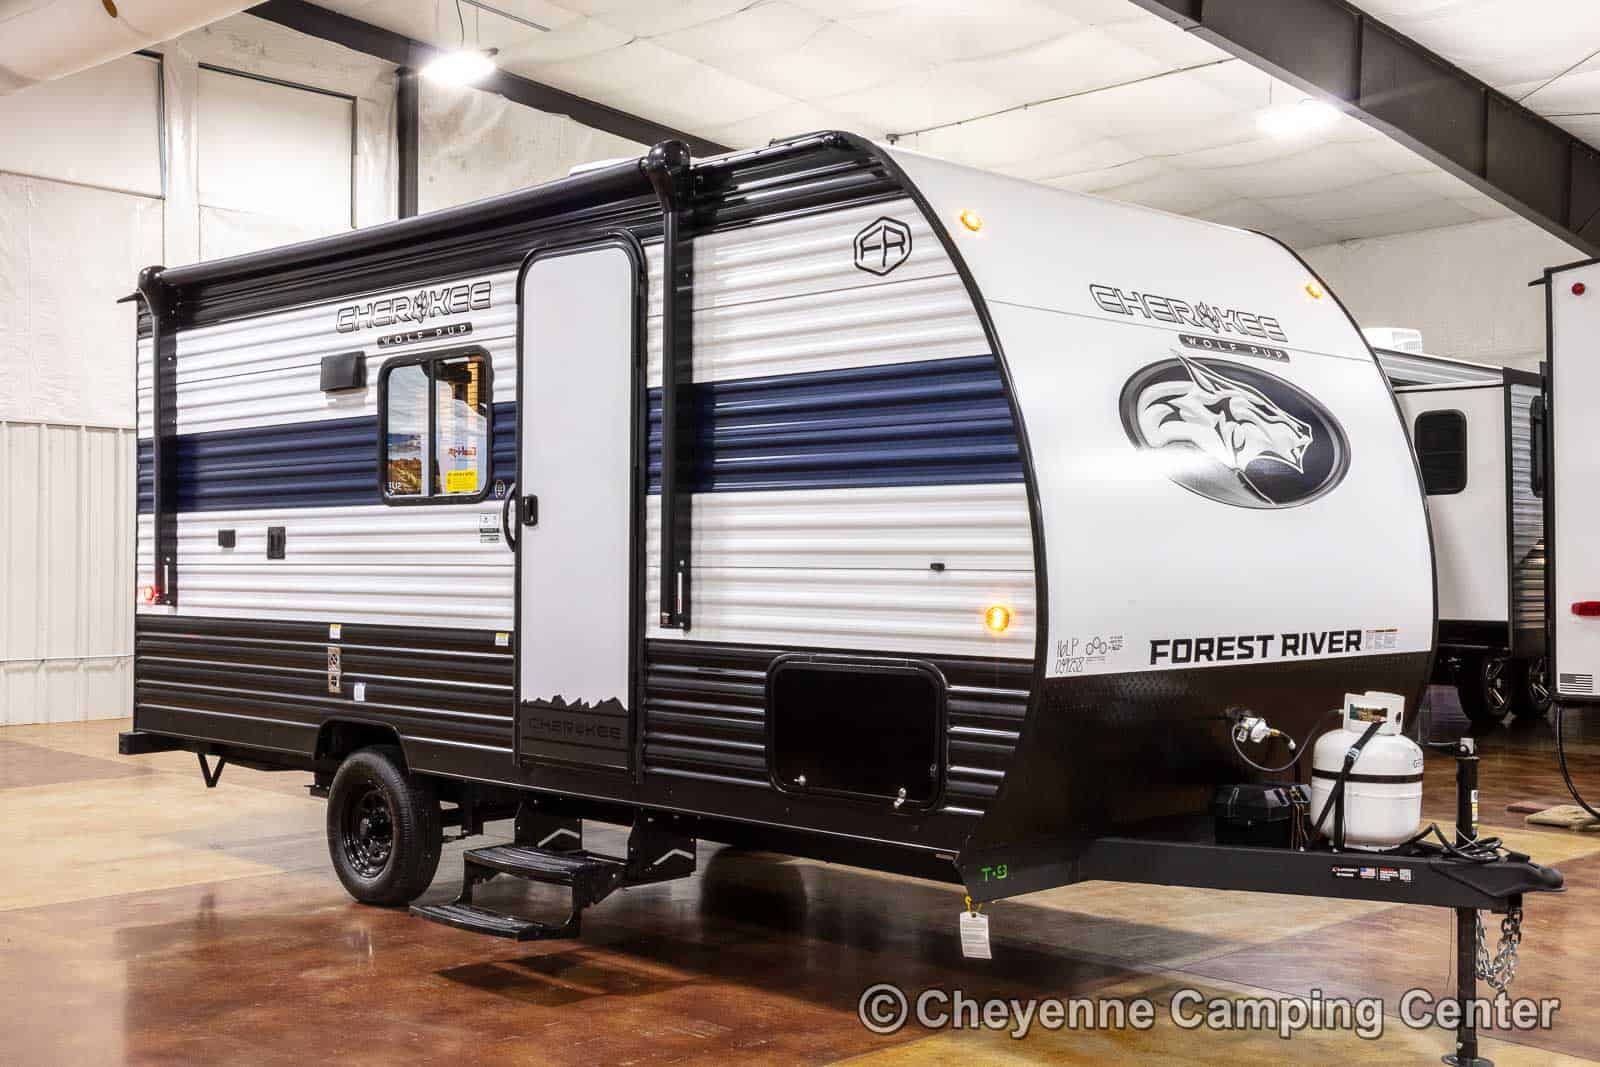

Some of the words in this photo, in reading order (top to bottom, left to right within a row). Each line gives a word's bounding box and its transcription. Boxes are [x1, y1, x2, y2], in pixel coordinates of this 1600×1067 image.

[382, 332, 424, 346] WOLF
[436, 324, 468, 337] PUP
[1185, 336, 1238, 352] WOLF
[1251, 346, 1284, 360] PUP
[1149, 633, 1275, 665] FOREST
[1280, 629, 1363, 657] RIVER
